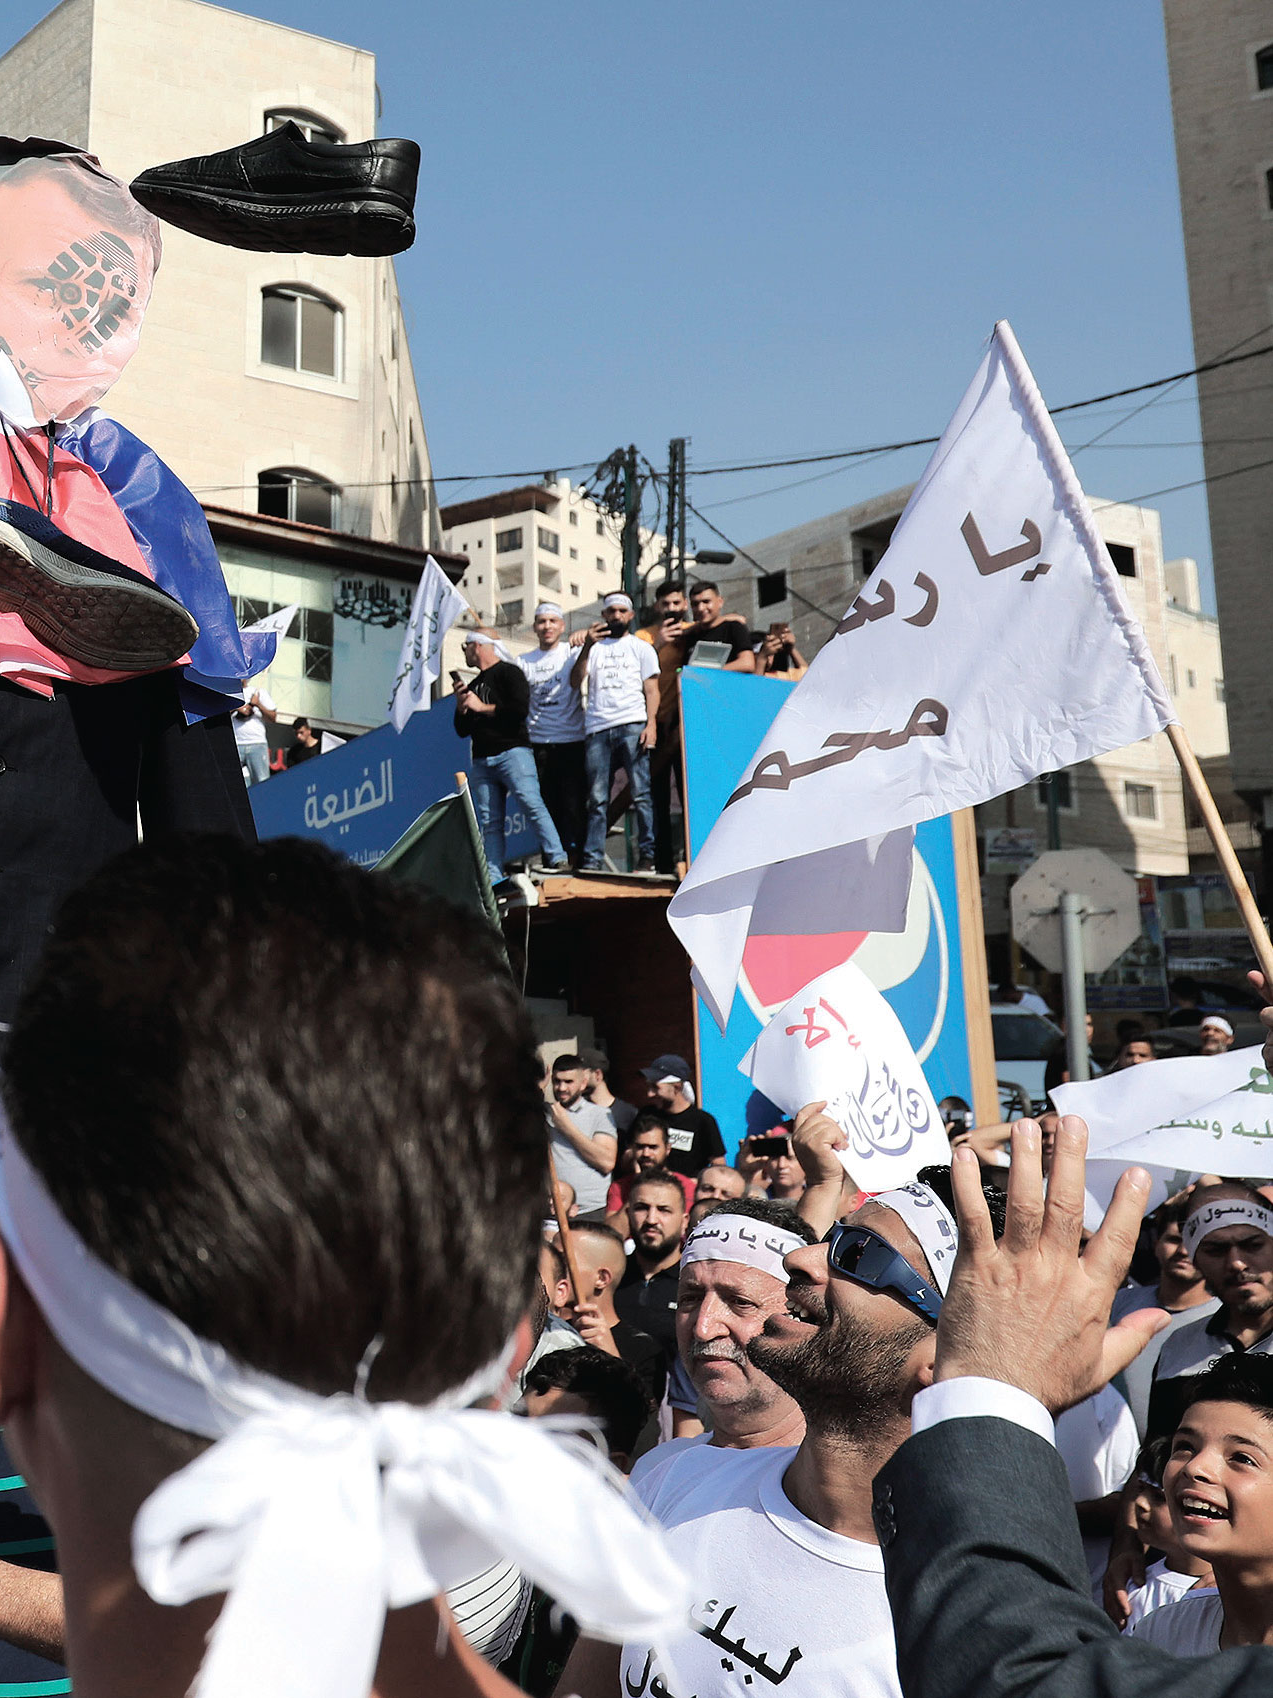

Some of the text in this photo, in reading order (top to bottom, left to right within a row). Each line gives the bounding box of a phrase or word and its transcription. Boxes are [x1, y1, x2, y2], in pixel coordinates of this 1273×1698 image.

[959, 509, 1051, 583] يا
[722, 697, 949, 811] محم
[303, 757, 394, 835] الضيعة
[785, 996, 862, 1051] إلا
[738, 1227, 757, 1250] يا
[1204, 1206, 1253, 1224] رسول
